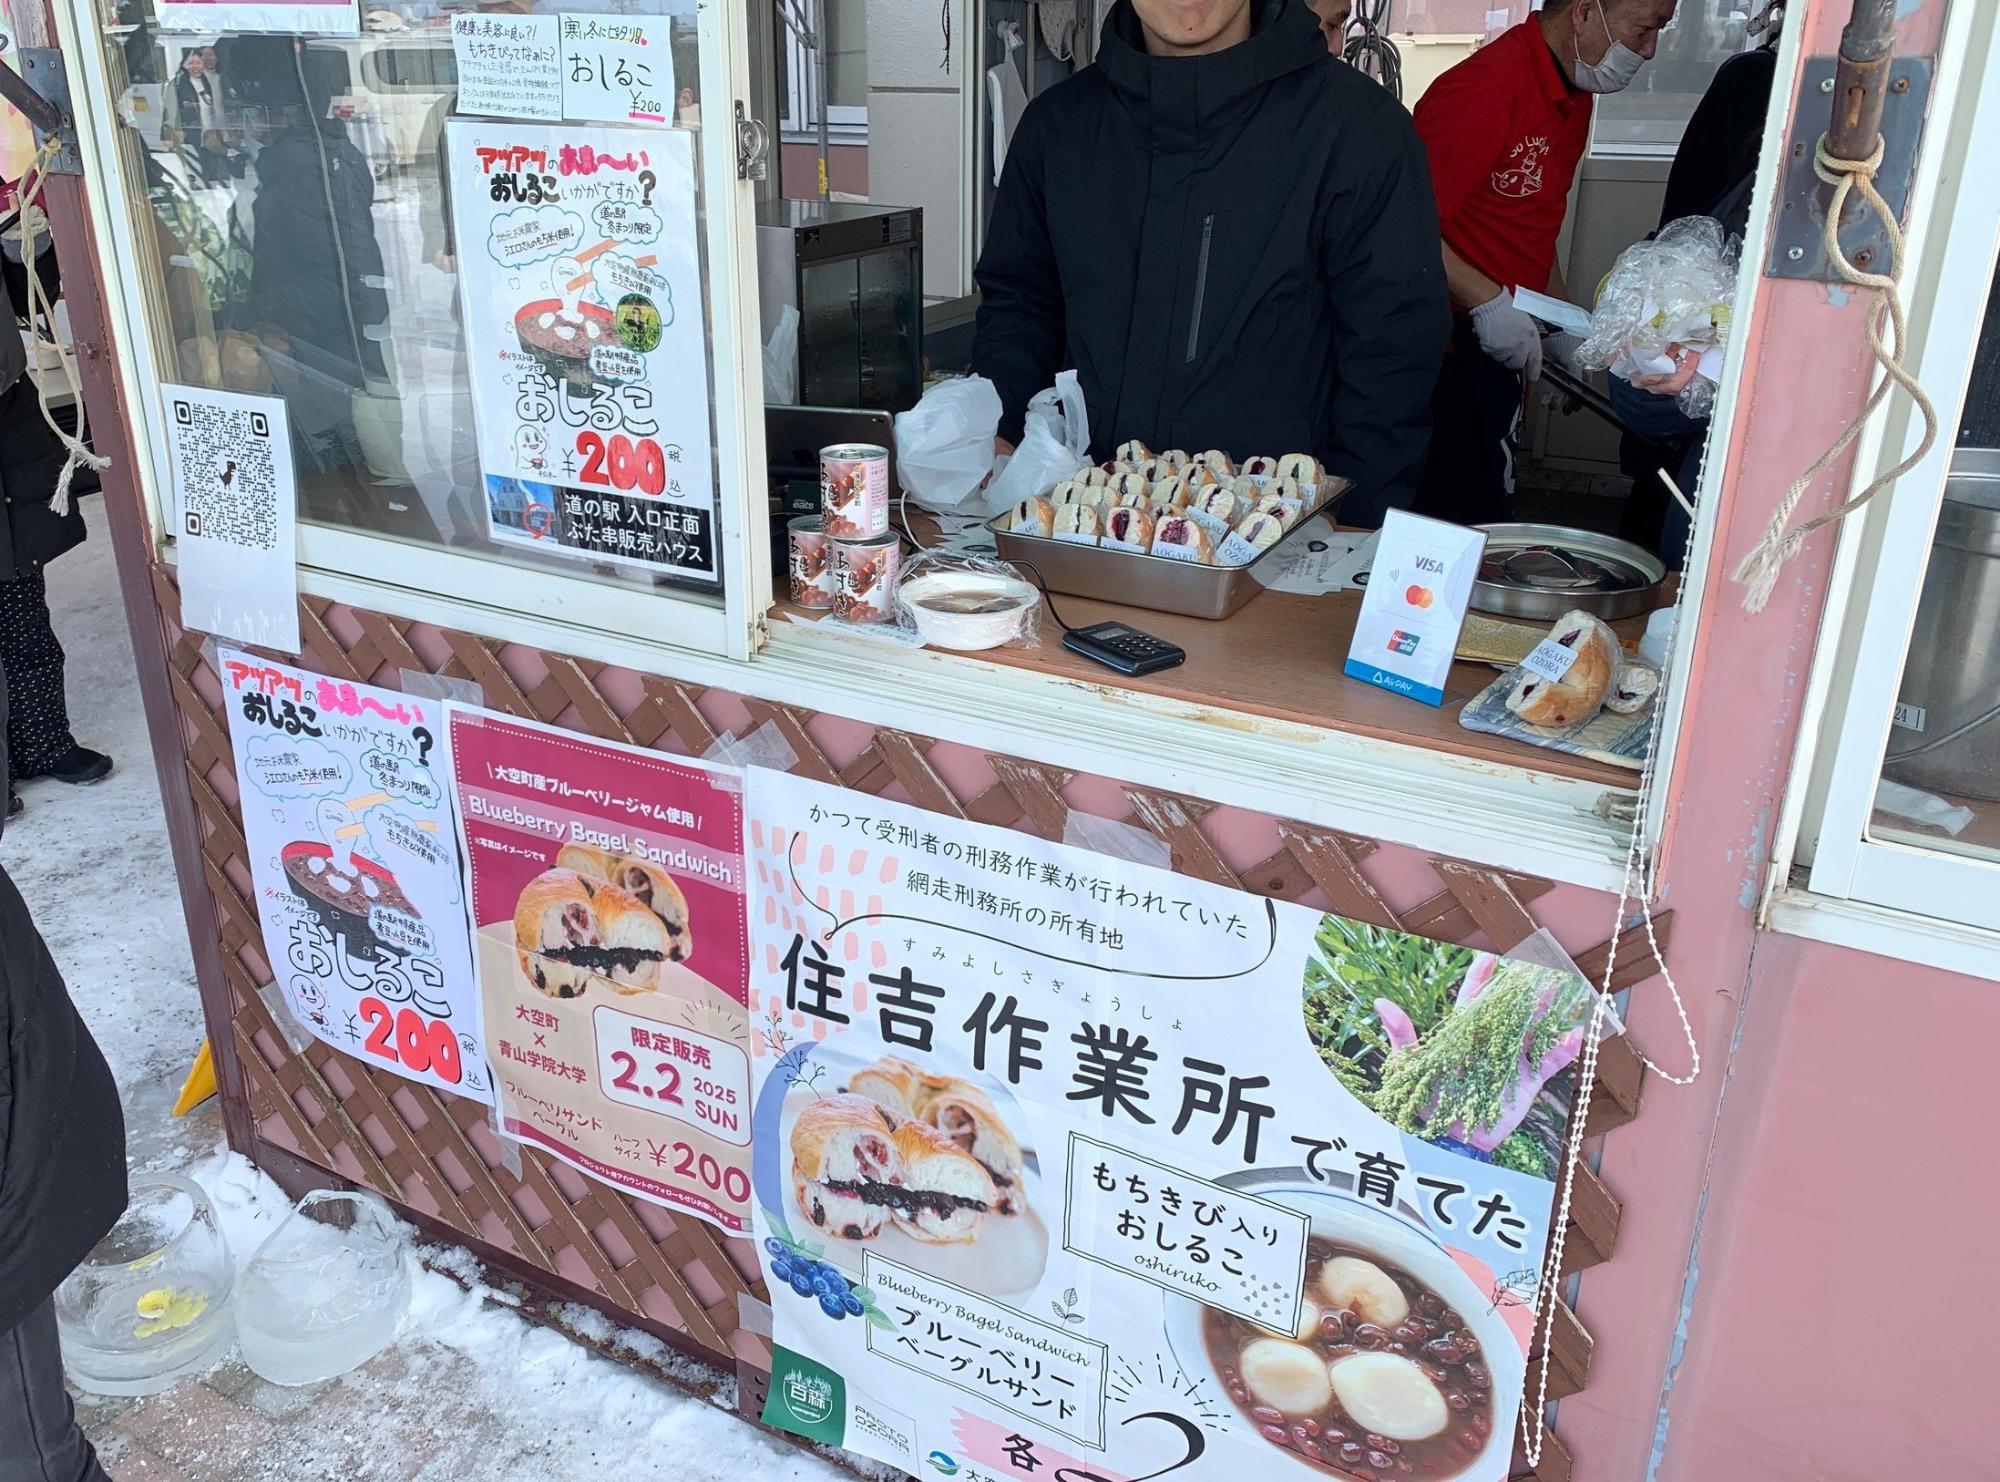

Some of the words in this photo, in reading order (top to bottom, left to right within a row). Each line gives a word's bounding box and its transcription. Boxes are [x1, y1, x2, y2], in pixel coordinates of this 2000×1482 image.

[568, 53, 652, 91] おしるこ
[629, 89, 662, 117] ¥200
[516, 373, 659, 437] おしるこ
[562, 431, 666, 496] ¥200
[565, 494, 621, 523] 道の駅
[627, 504, 700, 535] 入口正面
[567, 521, 703, 562] ぶた串販売ハウス
[1415, 555, 1444, 575] VISA
[1532, 654, 1560, 676] OZORA
[1536, 645, 1571, 669] AOGAKU
[469, 794, 566, 838] Blueberry
[571, 821, 629, 852] Bagel
[634, 841, 733, 884] Sandwich
[809, 804, 1248, 939] かつて受刑者の刑務作業が行われていた
[907, 869, 1125, 951] 網走刑務所の所有地
[288, 920, 452, 1018] おしるこ
[902, 937, 1184, 1031] すみよしさぎょうしょ
[343, 997, 462, 1084] ¥200
[515, 1004, 560, 1033] 大空町
[498, 1040, 587, 1084] 青山学院大学
[631, 1026, 712, 1070] 限定販売
[610, 1051, 684, 1107] 2.2
[694, 1077, 736, 1105] 2025
[695, 1100, 738, 1132] SUN
[646, 1138, 750, 1203] ¥200
[1093, 1162, 1278, 1246] もちきび入り
[1116, 1209, 1244, 1277] おしるこ
[1134, 1252, 1222, 1293] oshiruko
[877, 1273, 953, 1320] Blueberry
[954, 1304, 1004, 1336] Bagel
[1005, 1324, 1092, 1367] Sandwich
[895, 1305, 1075, 1388] ブルーベリー
[896, 1334, 1078, 1420] ベーグルサンド
[855, 1405, 908, 1444] PROTO
[855, 1414, 910, 1453] OZORA
[1000, 1432, 1043, 1474] 各
